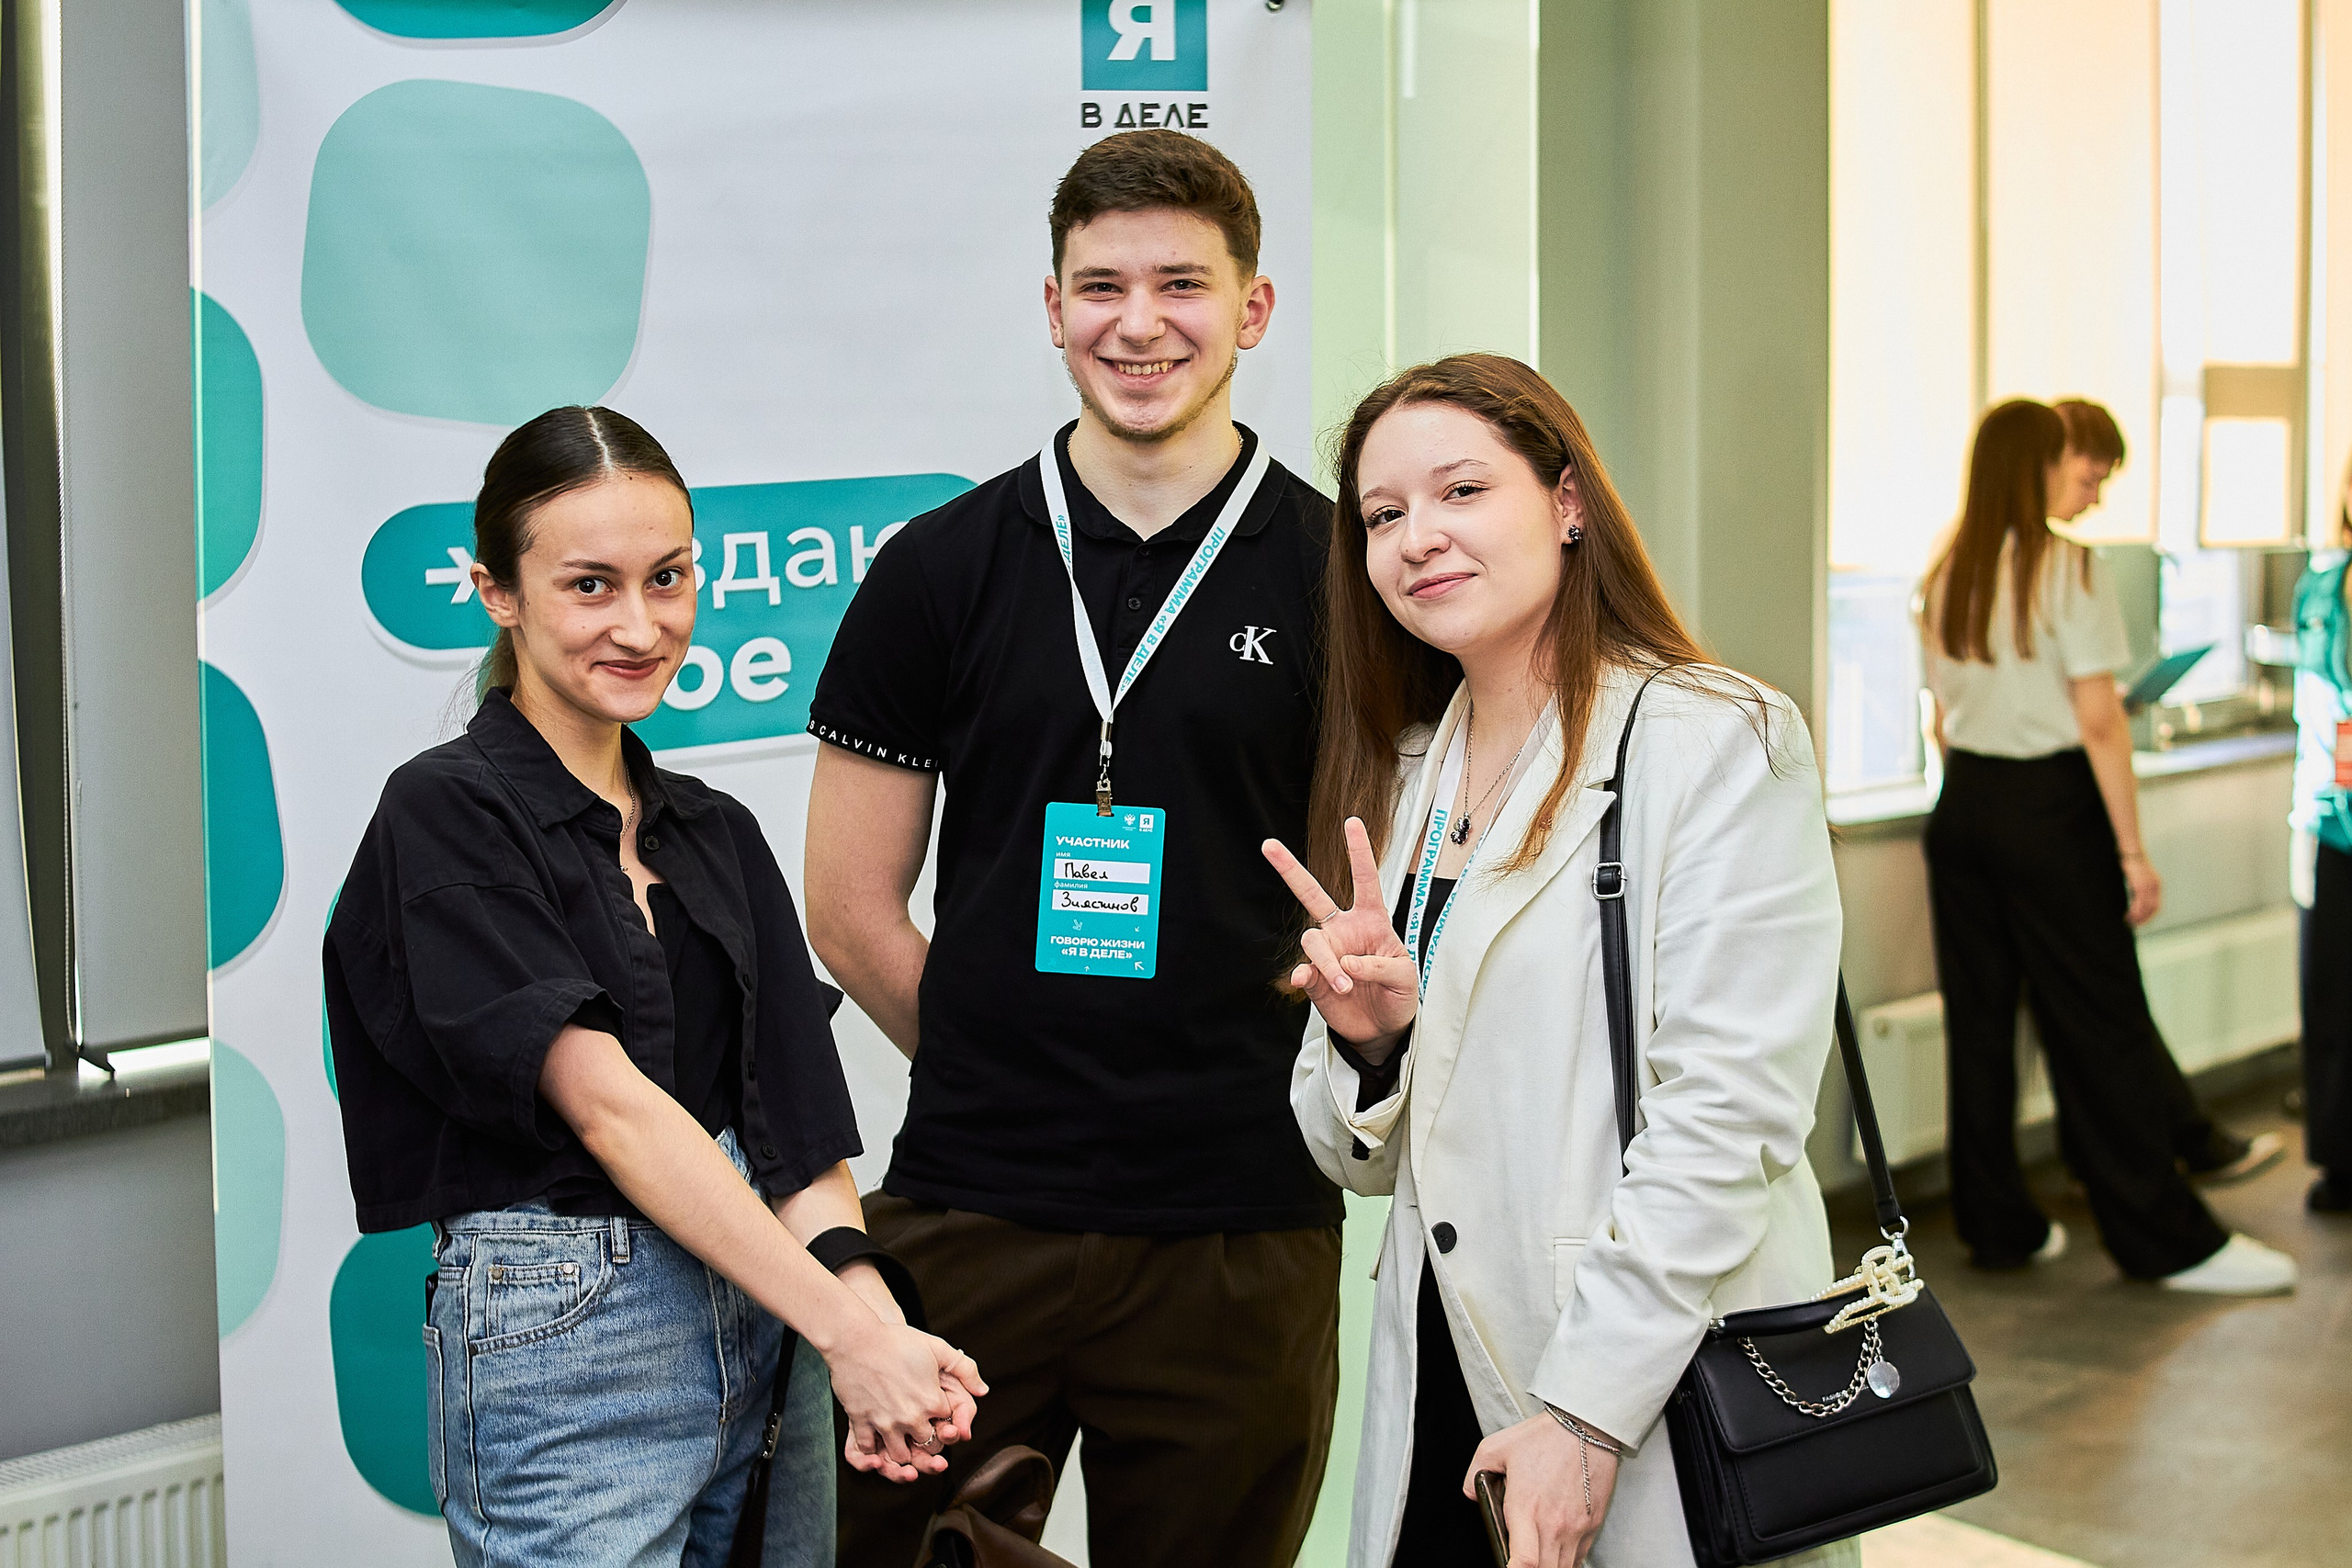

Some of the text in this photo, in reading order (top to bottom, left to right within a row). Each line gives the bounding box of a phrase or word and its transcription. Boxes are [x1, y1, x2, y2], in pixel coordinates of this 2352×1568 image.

[1107, 0, 1175, 60] Я
[1081, 102, 1209, 130] В ДЕЛЕ
[1165, 526, 1227, 615] ПРОГРАММА
[1148, 634, 1159, 648] В
[662, 636, 792, 711] ое
[1120, 645, 1149, 693] ДЕЛЕ»
[820, 725, 888, 759] CALVIN
[1056, 836, 1130, 850] УЧАСТНИК
[1414, 808, 1448, 909] ПРОГРАММА
[1064, 862, 1108, 880] Павел
[1054, 881, 1088, 889] фамилия
[1409, 911, 1419, 930] «Я
[1050, 935, 1145, 950] ГОВОРЮ ЖИЗНИ
[1408, 934, 1417, 944] В
[1061, 948, 1133, 959] «Я В ДЕЛЕ»
